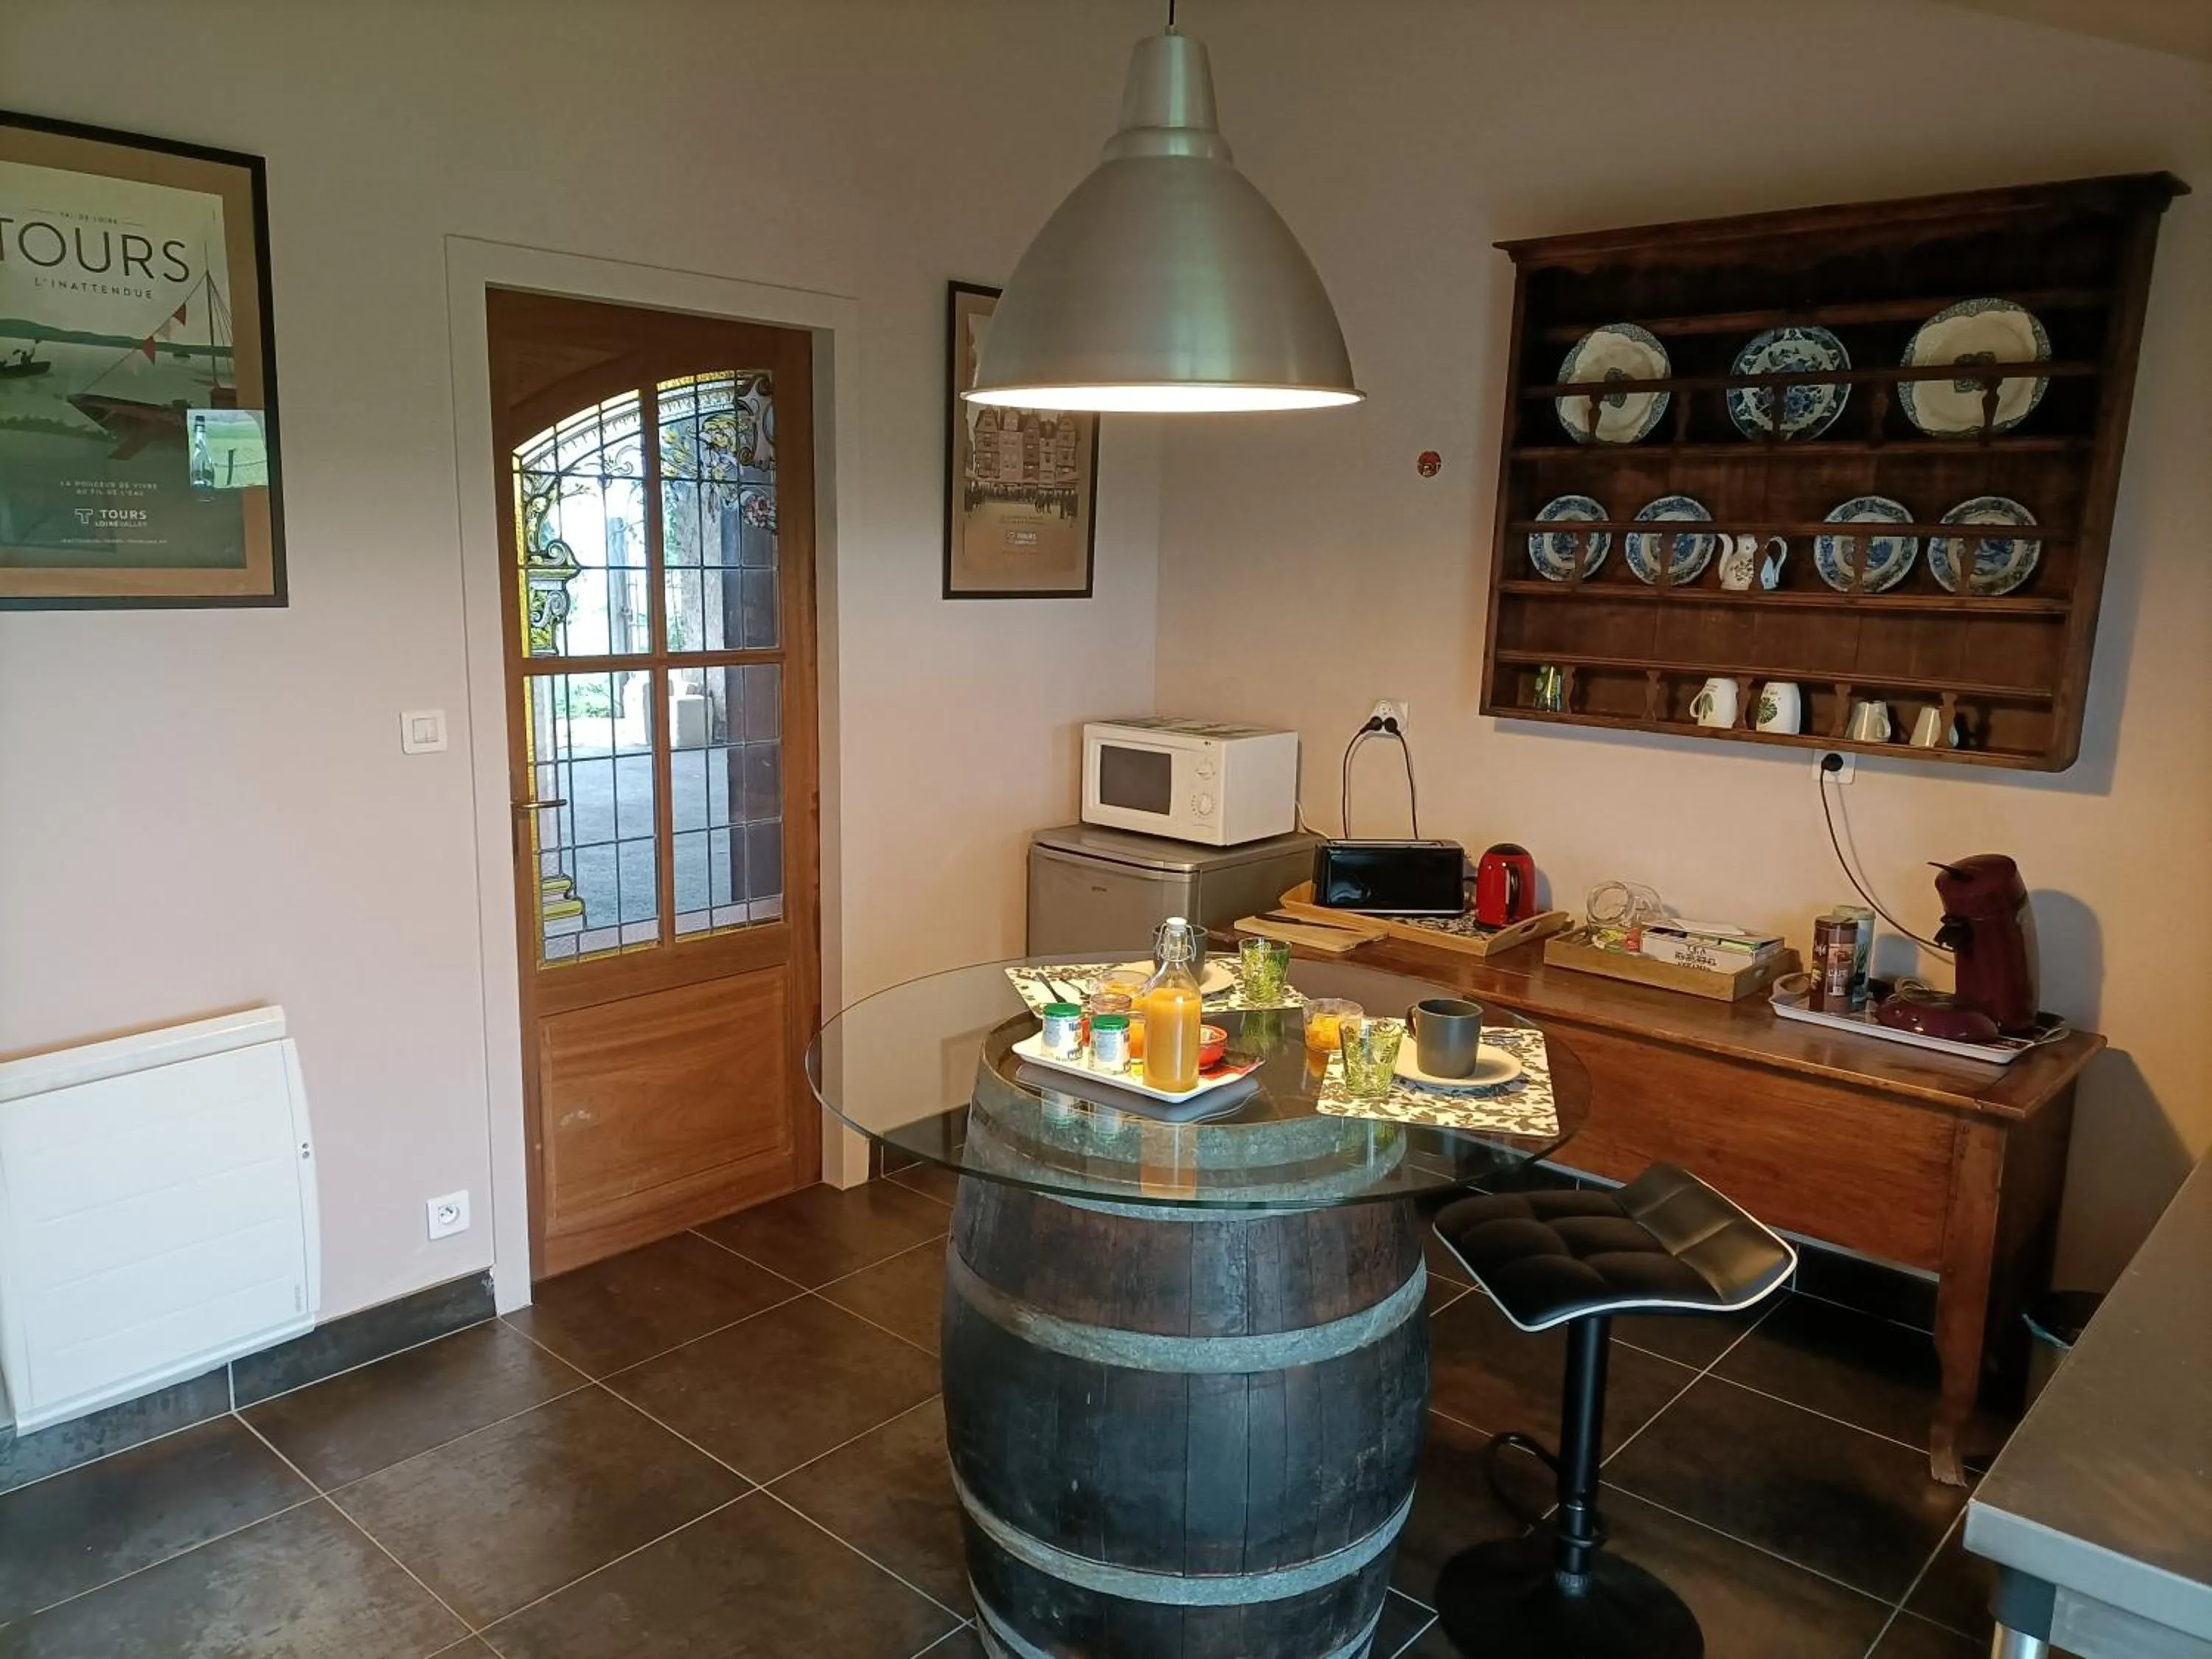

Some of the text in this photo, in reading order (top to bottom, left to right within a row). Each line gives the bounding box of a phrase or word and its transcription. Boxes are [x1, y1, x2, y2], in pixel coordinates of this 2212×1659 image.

[0, 218, 189, 282] TOURS
[35, 276, 152, 299] L'INATTENDUE
[99, 509, 147, 520] TOURS
